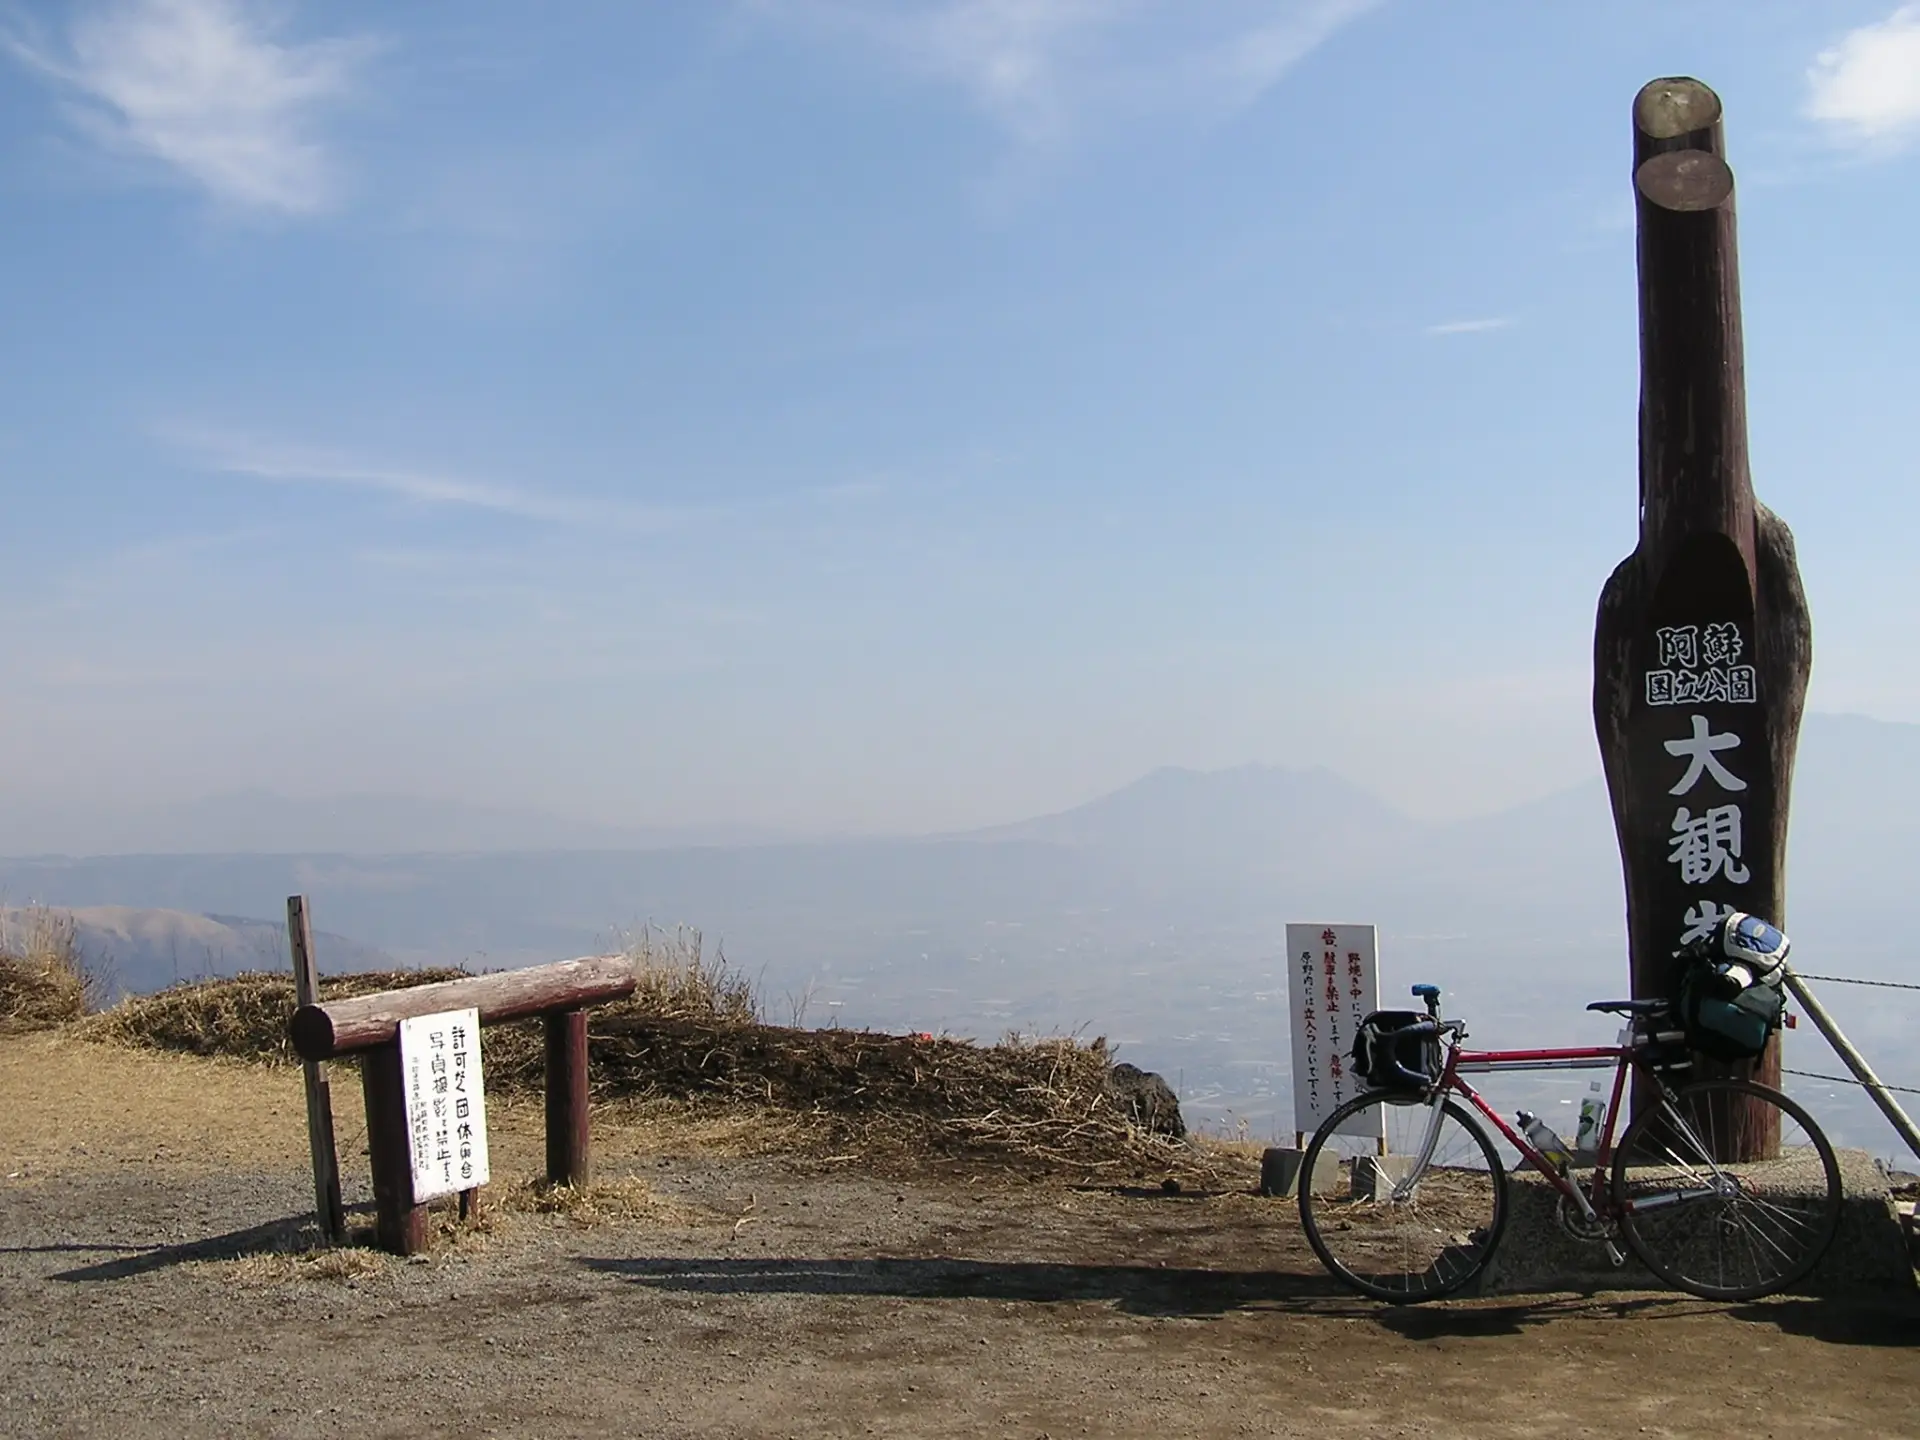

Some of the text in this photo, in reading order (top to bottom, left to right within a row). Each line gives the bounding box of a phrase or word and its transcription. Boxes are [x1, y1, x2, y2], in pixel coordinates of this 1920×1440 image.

[1656, 622, 1743, 668] 阿蘇
[1645, 665, 1756, 705] 国立公園
